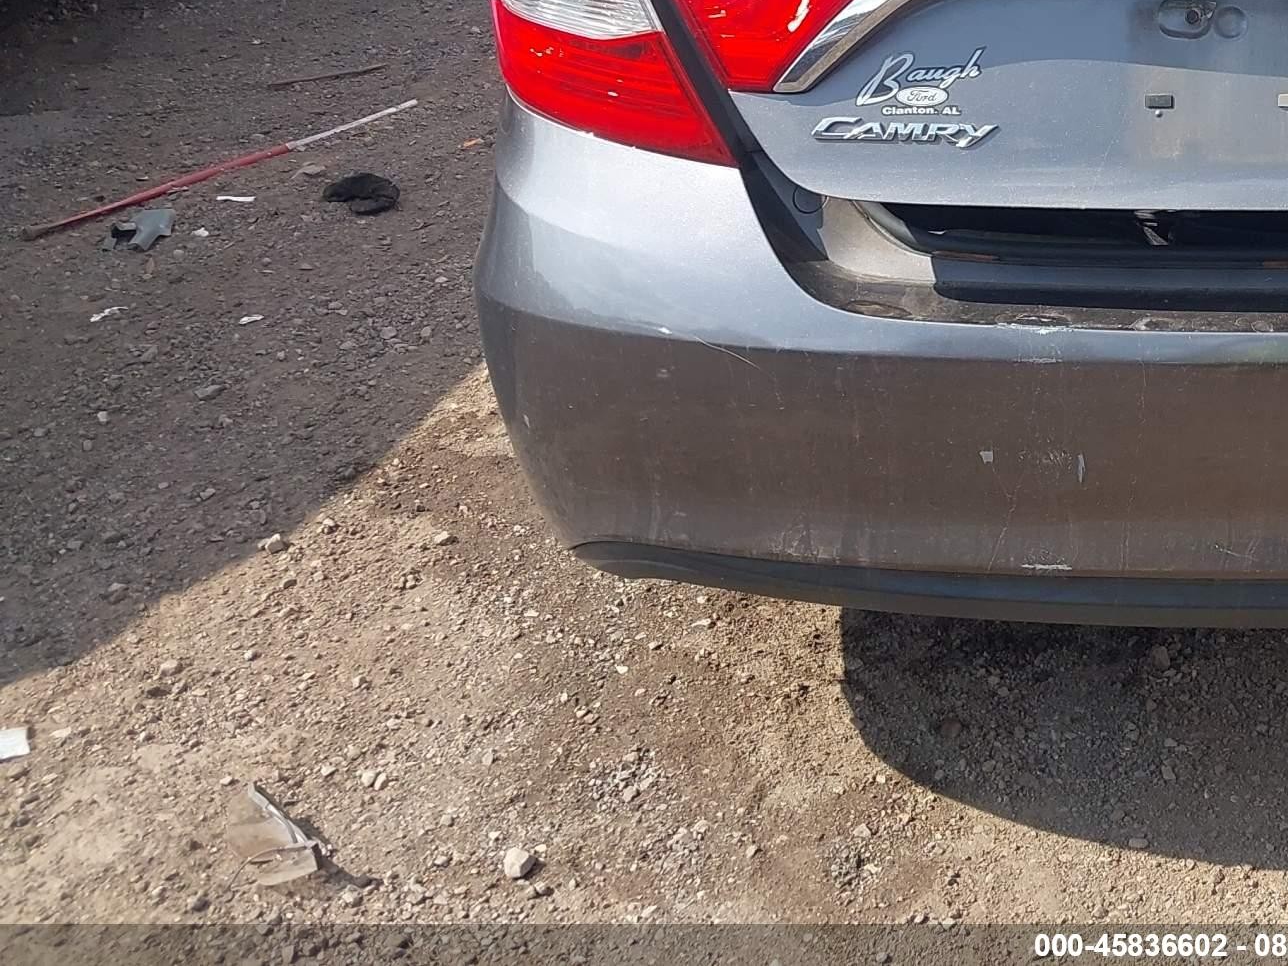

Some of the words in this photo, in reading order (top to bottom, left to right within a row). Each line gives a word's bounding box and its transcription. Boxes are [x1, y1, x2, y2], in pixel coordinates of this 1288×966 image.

[856, 47, 986, 106] Baugh
[906, 89, 937, 103] Ford
[943, 106, 961, 116] AL
[811, 115, 1000, 149] CAMRY
